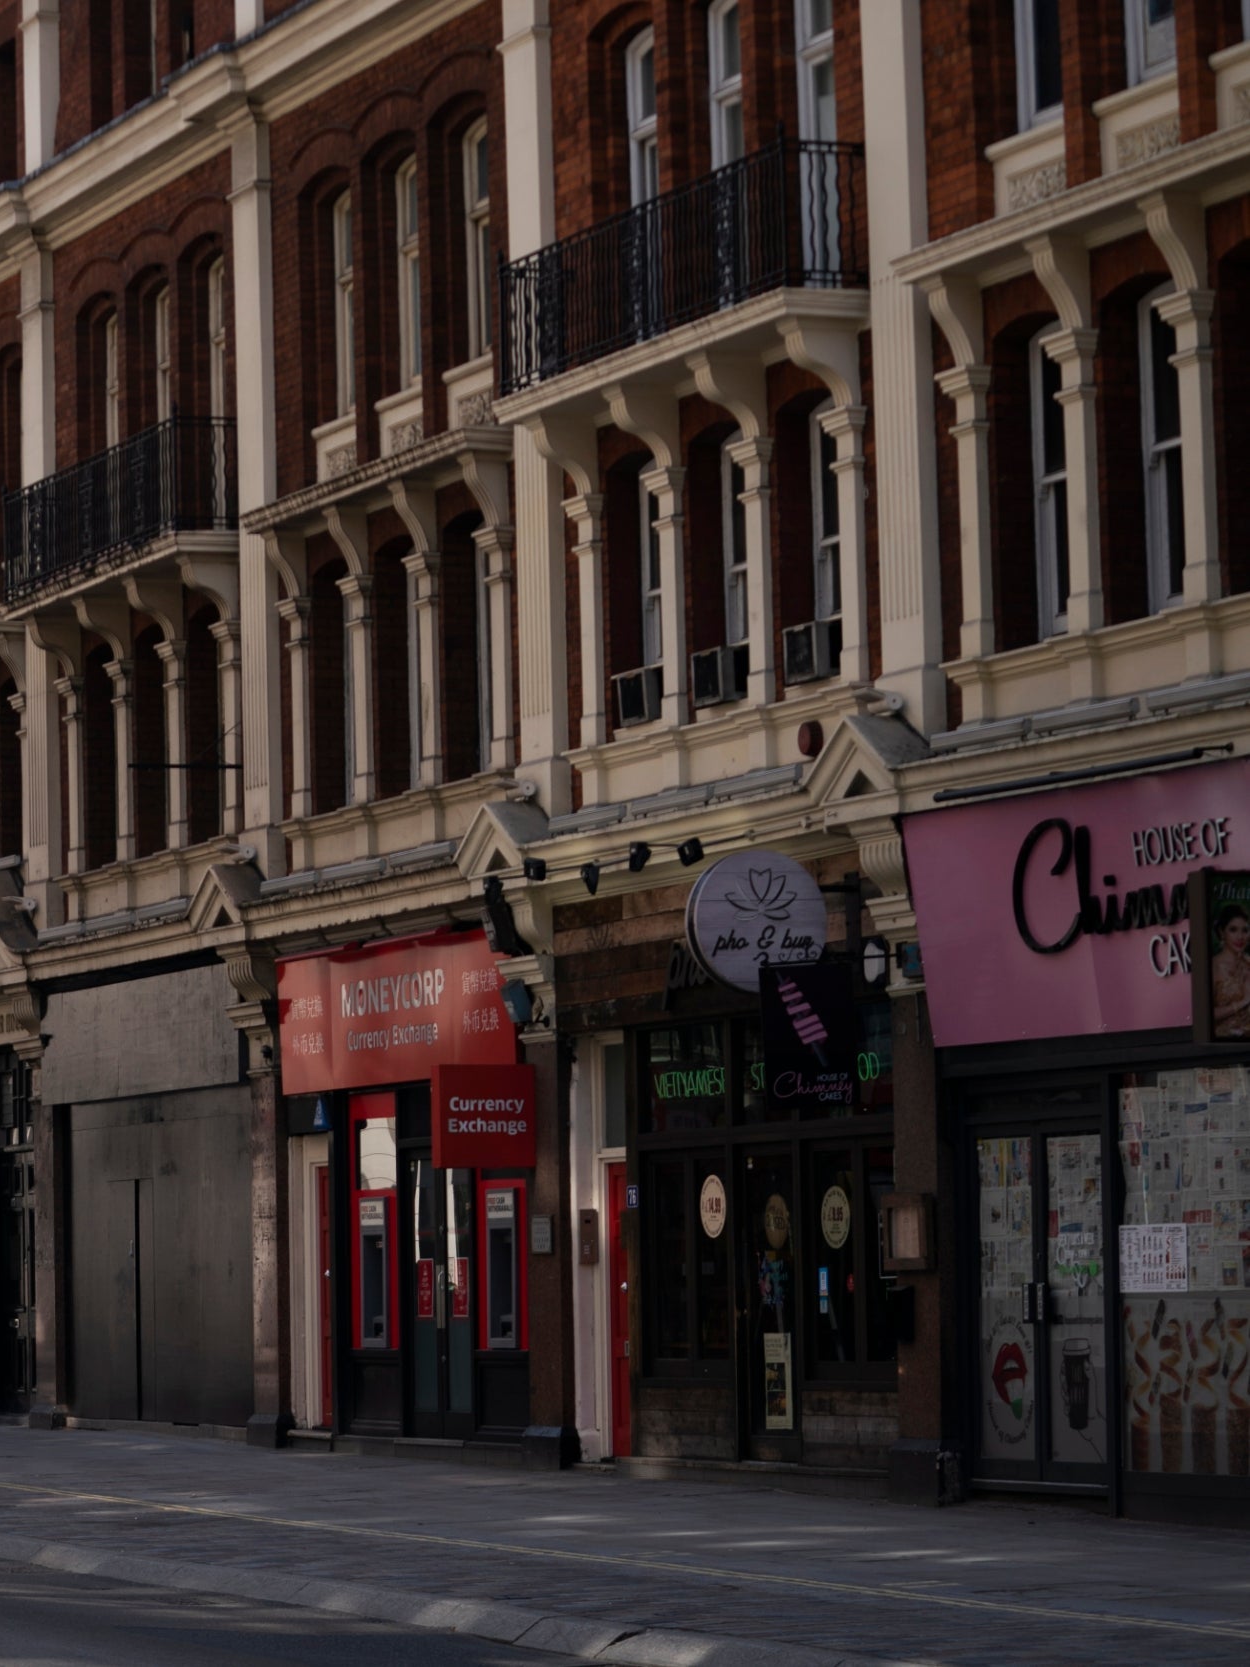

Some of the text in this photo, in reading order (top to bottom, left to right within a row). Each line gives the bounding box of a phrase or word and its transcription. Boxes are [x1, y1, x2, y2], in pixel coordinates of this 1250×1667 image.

[1132, 817, 1230, 867] HOUSE OF
[1013, 818, 1190, 954] Chimn
[1150, 933, 1192, 978] CAK
[342, 968, 445, 1018] MONEYCORP
[347, 1022, 439, 1051] Currency Exchange
[447, 1117, 527, 1135] Exchange
[449, 1096, 524, 1114] Currency
